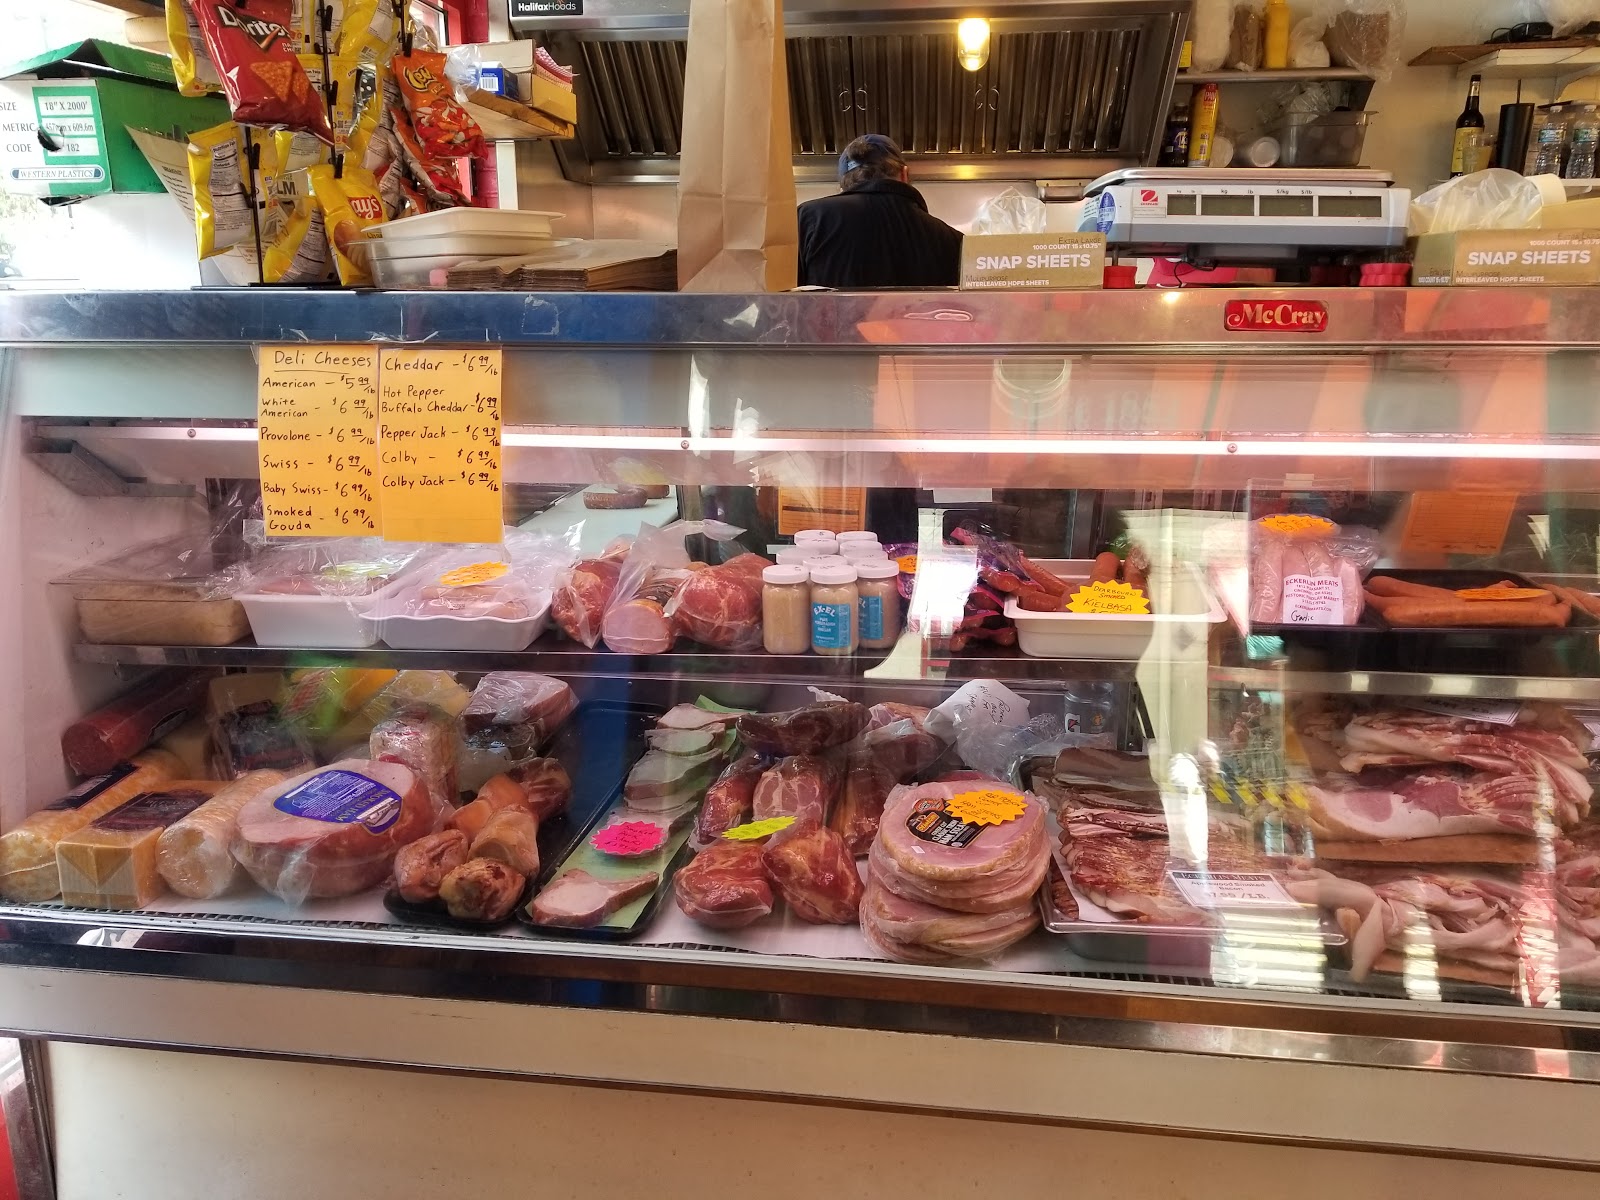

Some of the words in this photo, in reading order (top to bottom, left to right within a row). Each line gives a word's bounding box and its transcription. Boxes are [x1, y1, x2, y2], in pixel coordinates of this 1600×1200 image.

[518, 2, 576, 11] HalifaxHoods
[3, 123, 36, 132] METRIC
[6, 144, 32, 152] CODE
[67, 144, 79, 152] 182
[21, 170, 57, 178] WESTERN
[58, 170, 93, 178] PLASTICS
[976, 256, 1022, 270] SNAP
[1026, 254, 1091, 269] SHEETS
[1467, 251, 1517, 265] SNAP
[1521, 250, 1591, 264] SHEETS
[1227, 303, 1325, 327] McCray
[274, 350, 305, 365] Deli
[314, 351, 371, 367] Cheeses
[385, 358, 443, 371] Cheddar
[262, 377, 316, 388] American
[383, 386, 402, 398] Hot
[408, 385, 445, 400] Pepper
[261, 409, 308, 417] American
[382, 402, 422, 413] Buffalo
[427, 401, 468, 413] Cheddar
[260, 426, 311, 441] Provolone
[381, 425, 416, 441] Pepper
[420, 426, 446, 438] Jack
[263, 455, 299, 469] Swiss
[382, 451, 417, 465] Colby
[263, 482, 286, 496] Baby
[383, 476, 414, 489] Colby
[420, 476, 444, 486] Jack
[267, 505, 312, 516] Smoked
[270, 519, 312, 531] Gouda
[813, 604, 836, 617] EX-EL
[1083, 598, 1132, 612] KIELBASA
[1291, 610, 1314, 622] Garlic
